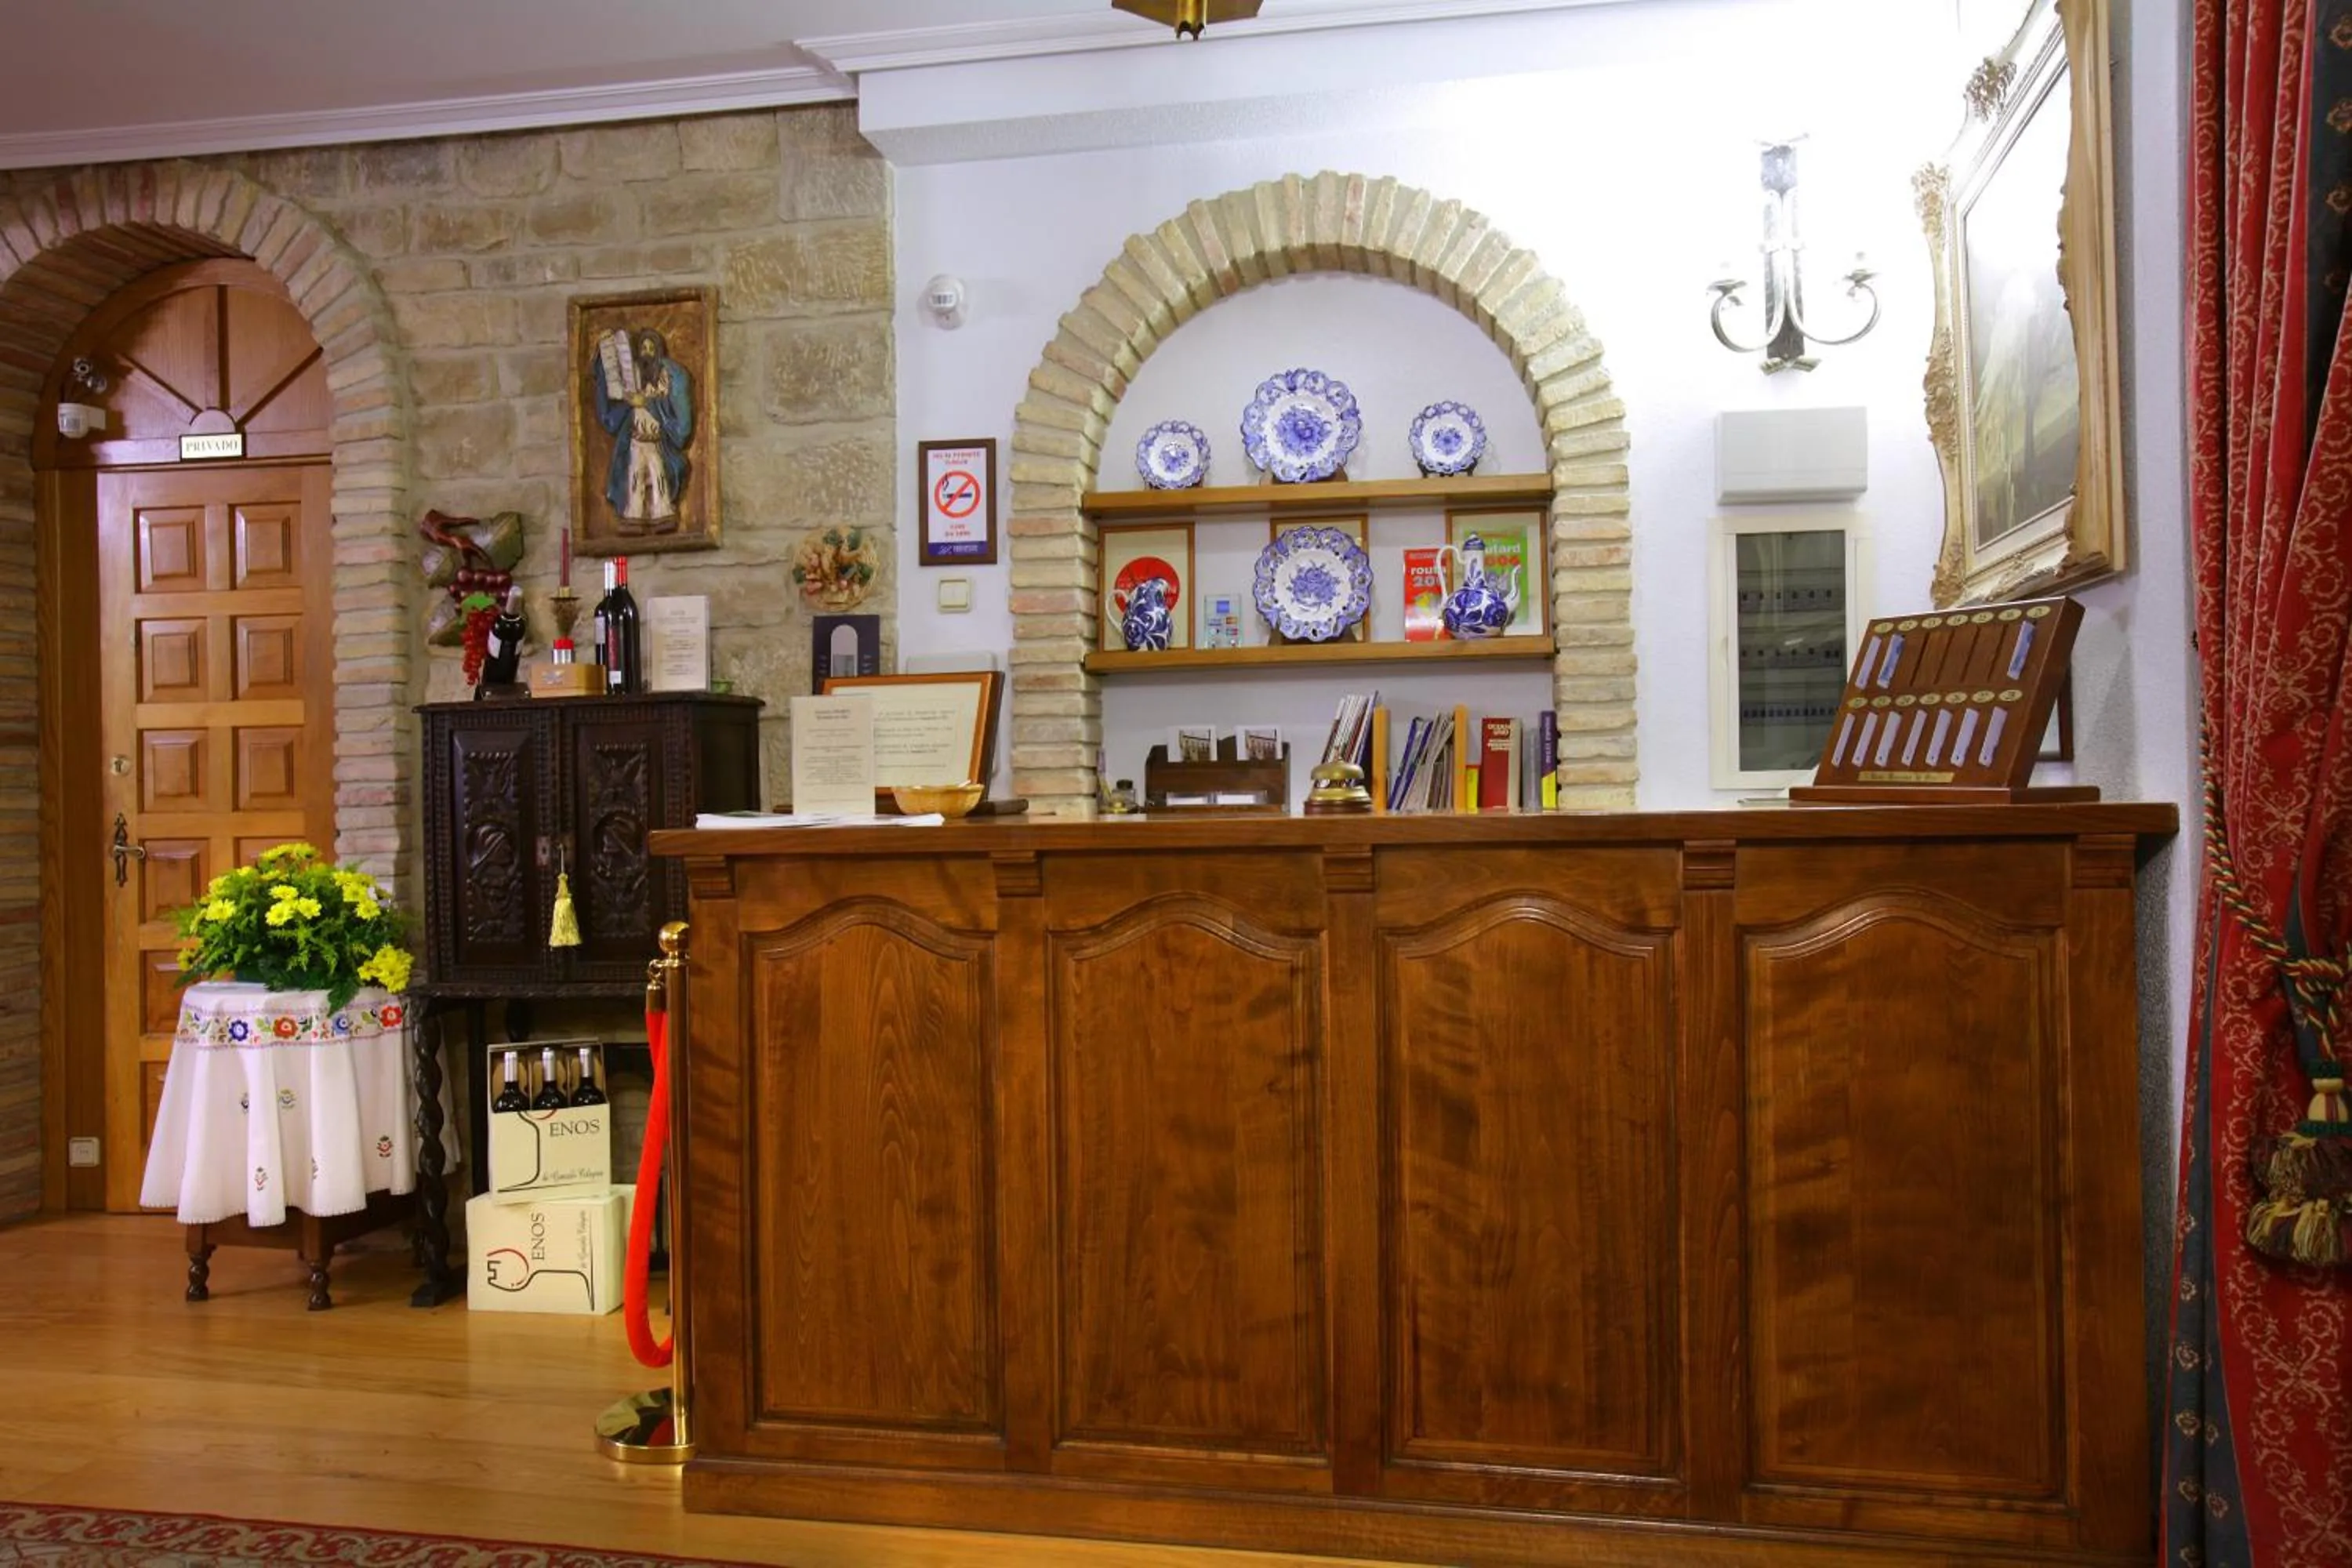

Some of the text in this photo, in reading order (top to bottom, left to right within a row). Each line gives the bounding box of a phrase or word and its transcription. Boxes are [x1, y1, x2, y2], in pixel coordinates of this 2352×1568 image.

[186, 440, 238, 452] PRIVADO
[1484, 543, 1520, 554] utard
[550, 1119, 601, 1137] ENOS
[532, 1213, 545, 1261] ENOS
